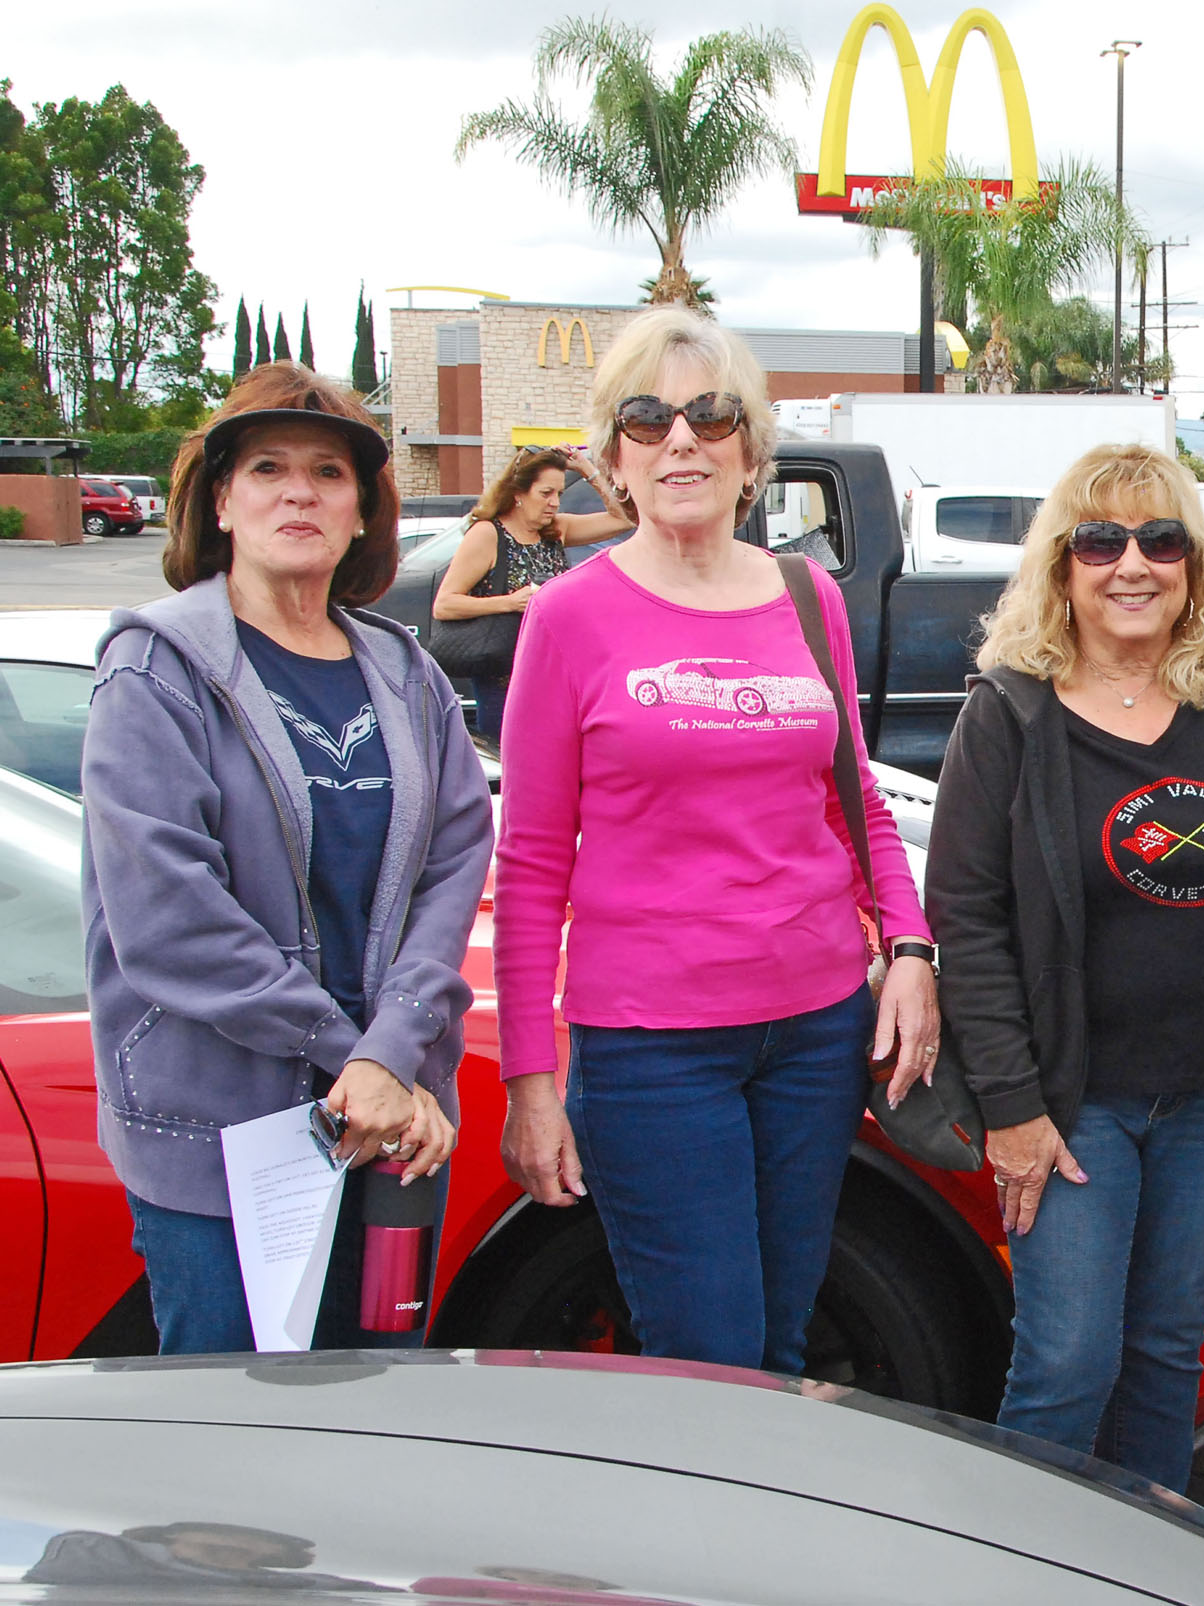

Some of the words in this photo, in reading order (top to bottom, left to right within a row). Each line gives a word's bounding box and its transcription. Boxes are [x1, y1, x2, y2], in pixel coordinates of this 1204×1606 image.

[669, 718, 688, 730] The
[691, 719, 736, 729] National
[737, 719, 775, 729] Corvette
[778, 716, 818, 727] Museum
[1116, 794, 1154, 824] SIMI
